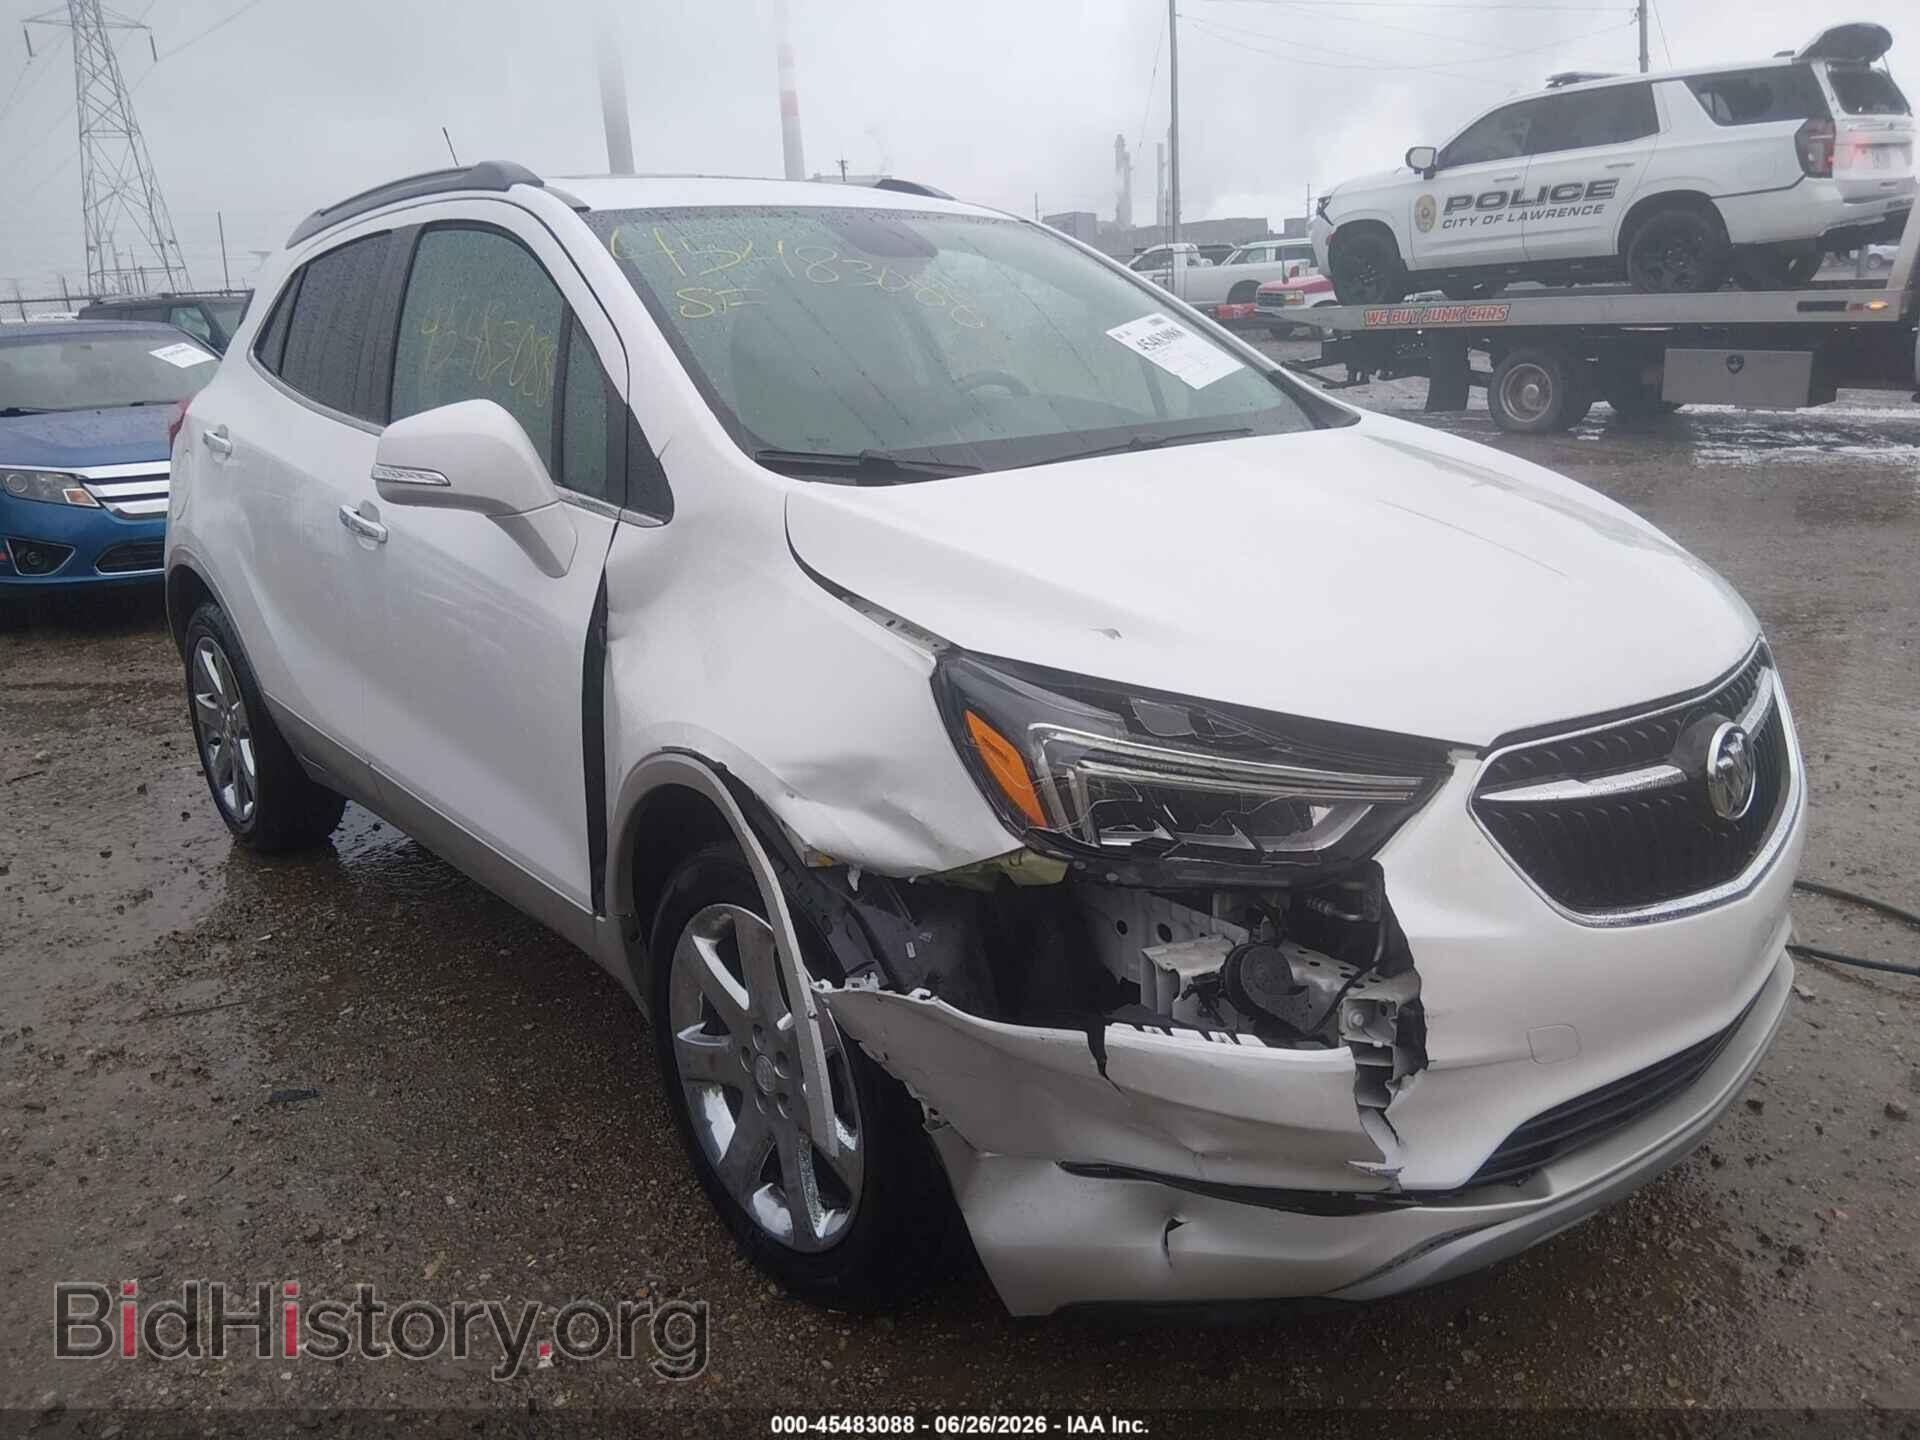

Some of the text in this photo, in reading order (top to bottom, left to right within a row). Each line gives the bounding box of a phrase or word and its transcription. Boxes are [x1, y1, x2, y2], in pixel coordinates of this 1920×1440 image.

[1443, 177, 1620, 216] POLICE
[1442, 204, 1605, 230] CITY OF LAWRENCE
[1364, 304, 1511, 326] WE BUY JUNK CARS
